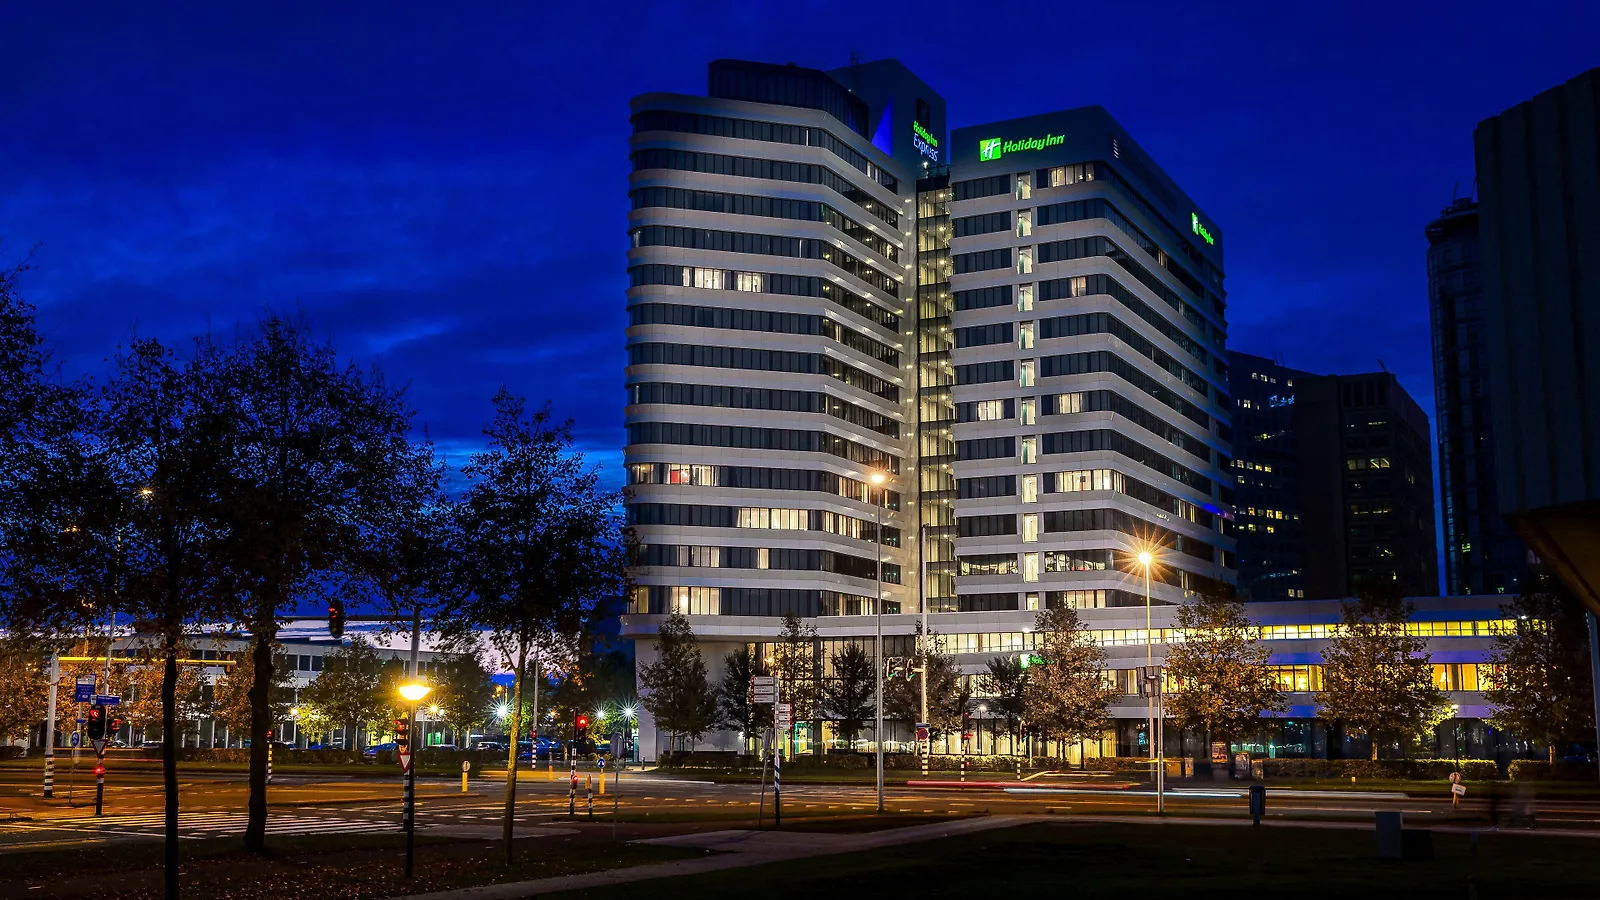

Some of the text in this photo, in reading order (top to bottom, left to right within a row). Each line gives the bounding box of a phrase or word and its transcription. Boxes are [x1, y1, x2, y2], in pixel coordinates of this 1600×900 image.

[913, 120, 930, 144] Holiday
[1003, 133, 1064, 153] Holiday Inn
[913, 132, 939, 162] Express
